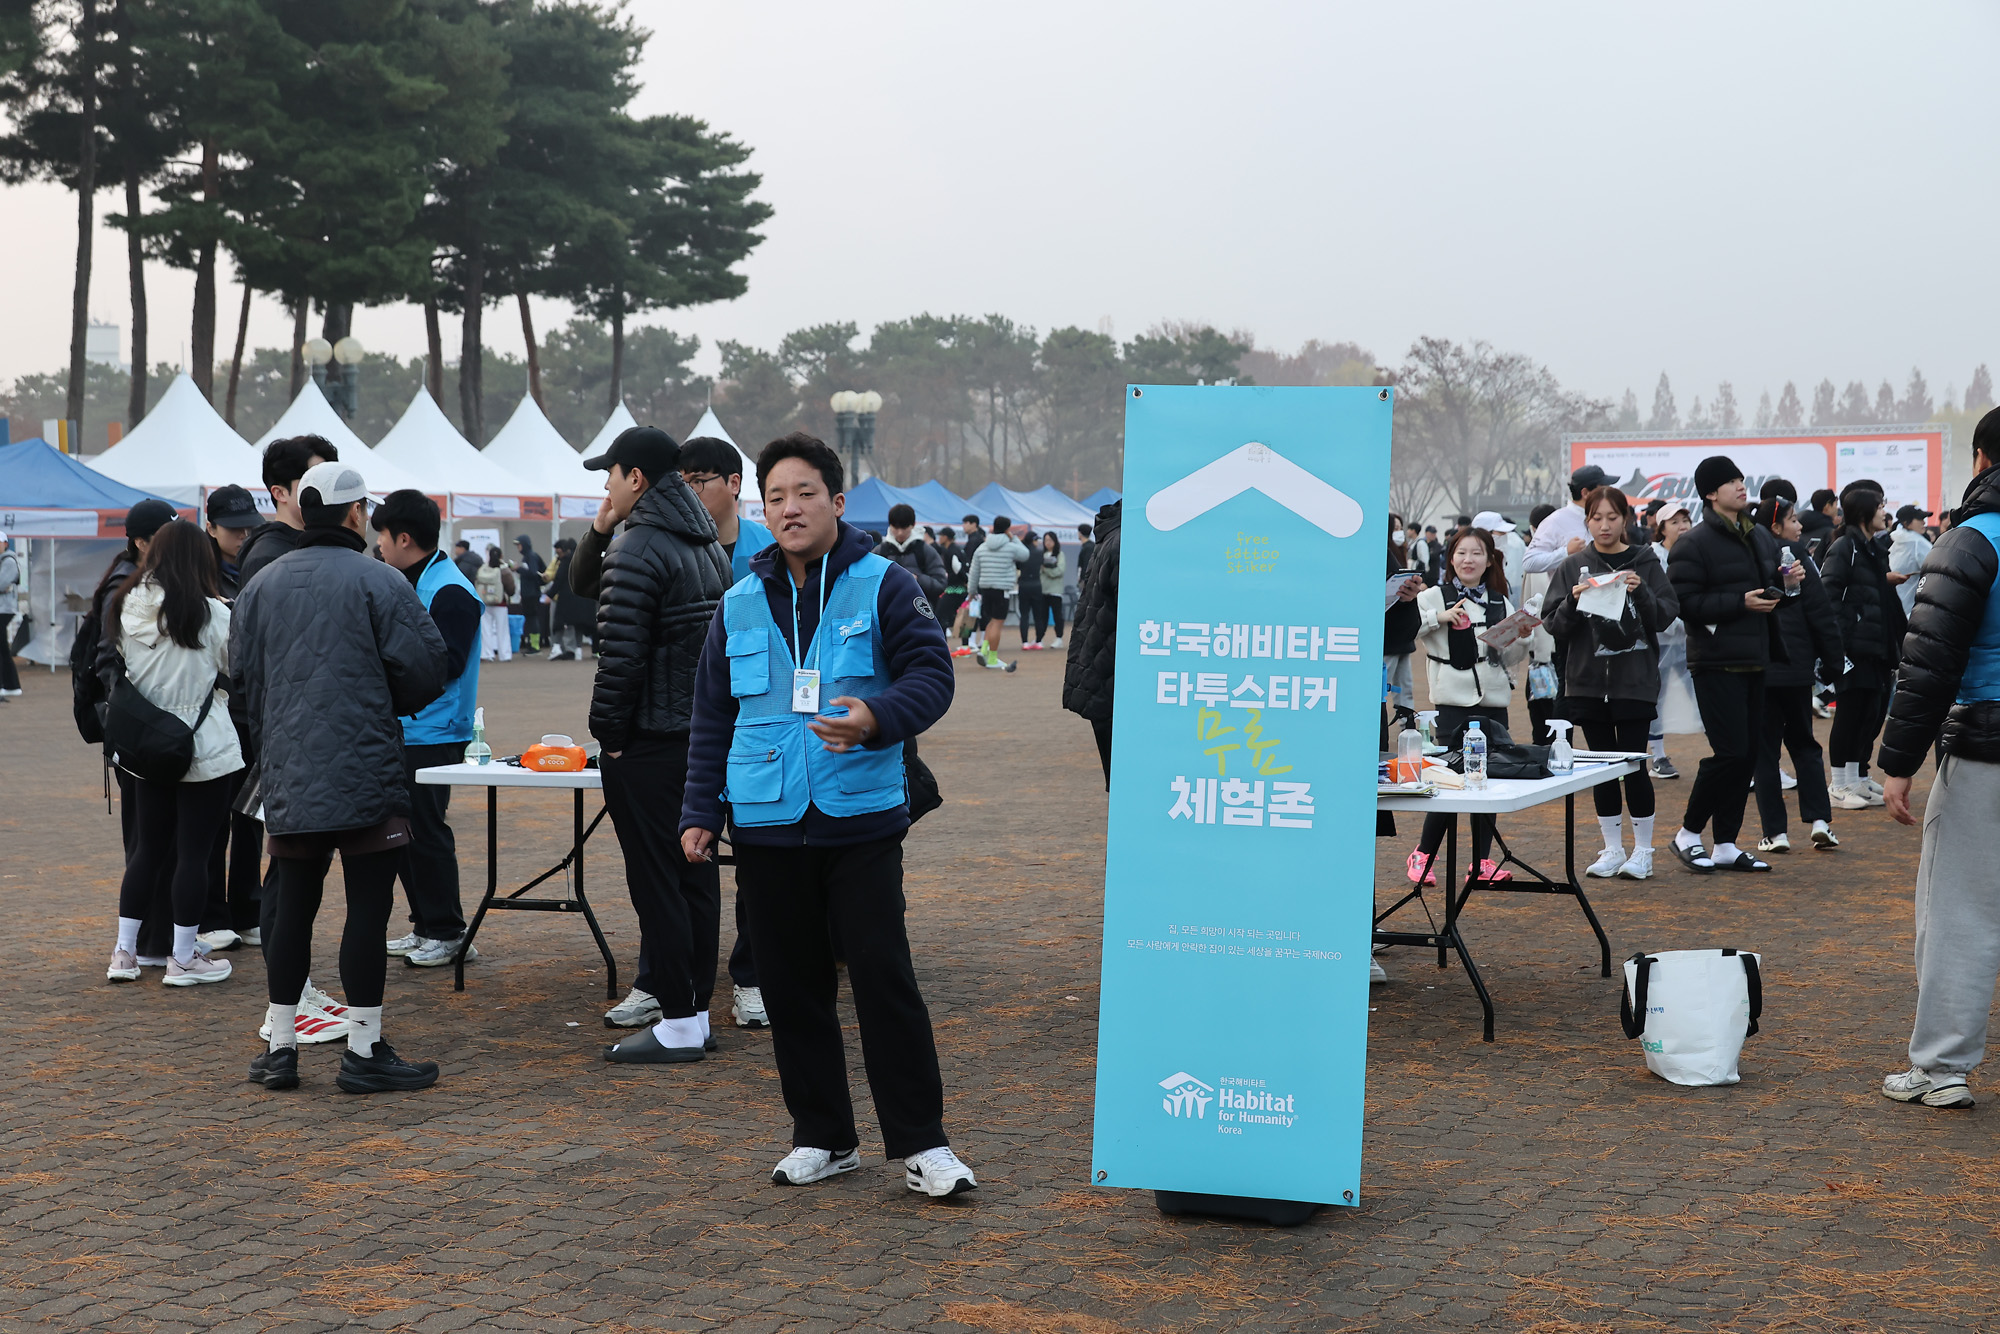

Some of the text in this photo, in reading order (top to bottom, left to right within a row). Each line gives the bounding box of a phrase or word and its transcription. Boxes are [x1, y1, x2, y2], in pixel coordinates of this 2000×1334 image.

[1236, 531, 1269, 546] free
[1224, 547, 1280, 560] tattoo
[1227, 561, 1277, 573] stiker
[1138, 619, 1361, 662] 한국해비타트
[1156, 671, 1338, 712] 타투스티커
[1197, 706, 1293, 776] 무료
[1167, 775, 1315, 829] 체험존
[1168, 924, 1301, 941] 집, 모든 희망이 시작 되는 곳입니다
[1127, 939, 1342, 961] 모든 사람에게 안락한 집이 있는 세상을 꿈꾸는 국제NGO
[1220, 1076, 1267, 1088] 한국해비타트
[1219, 1088, 1295, 1113] Habitat
[1218, 1109, 1235, 1122] for
[1218, 1124, 1243, 1135] Korea
